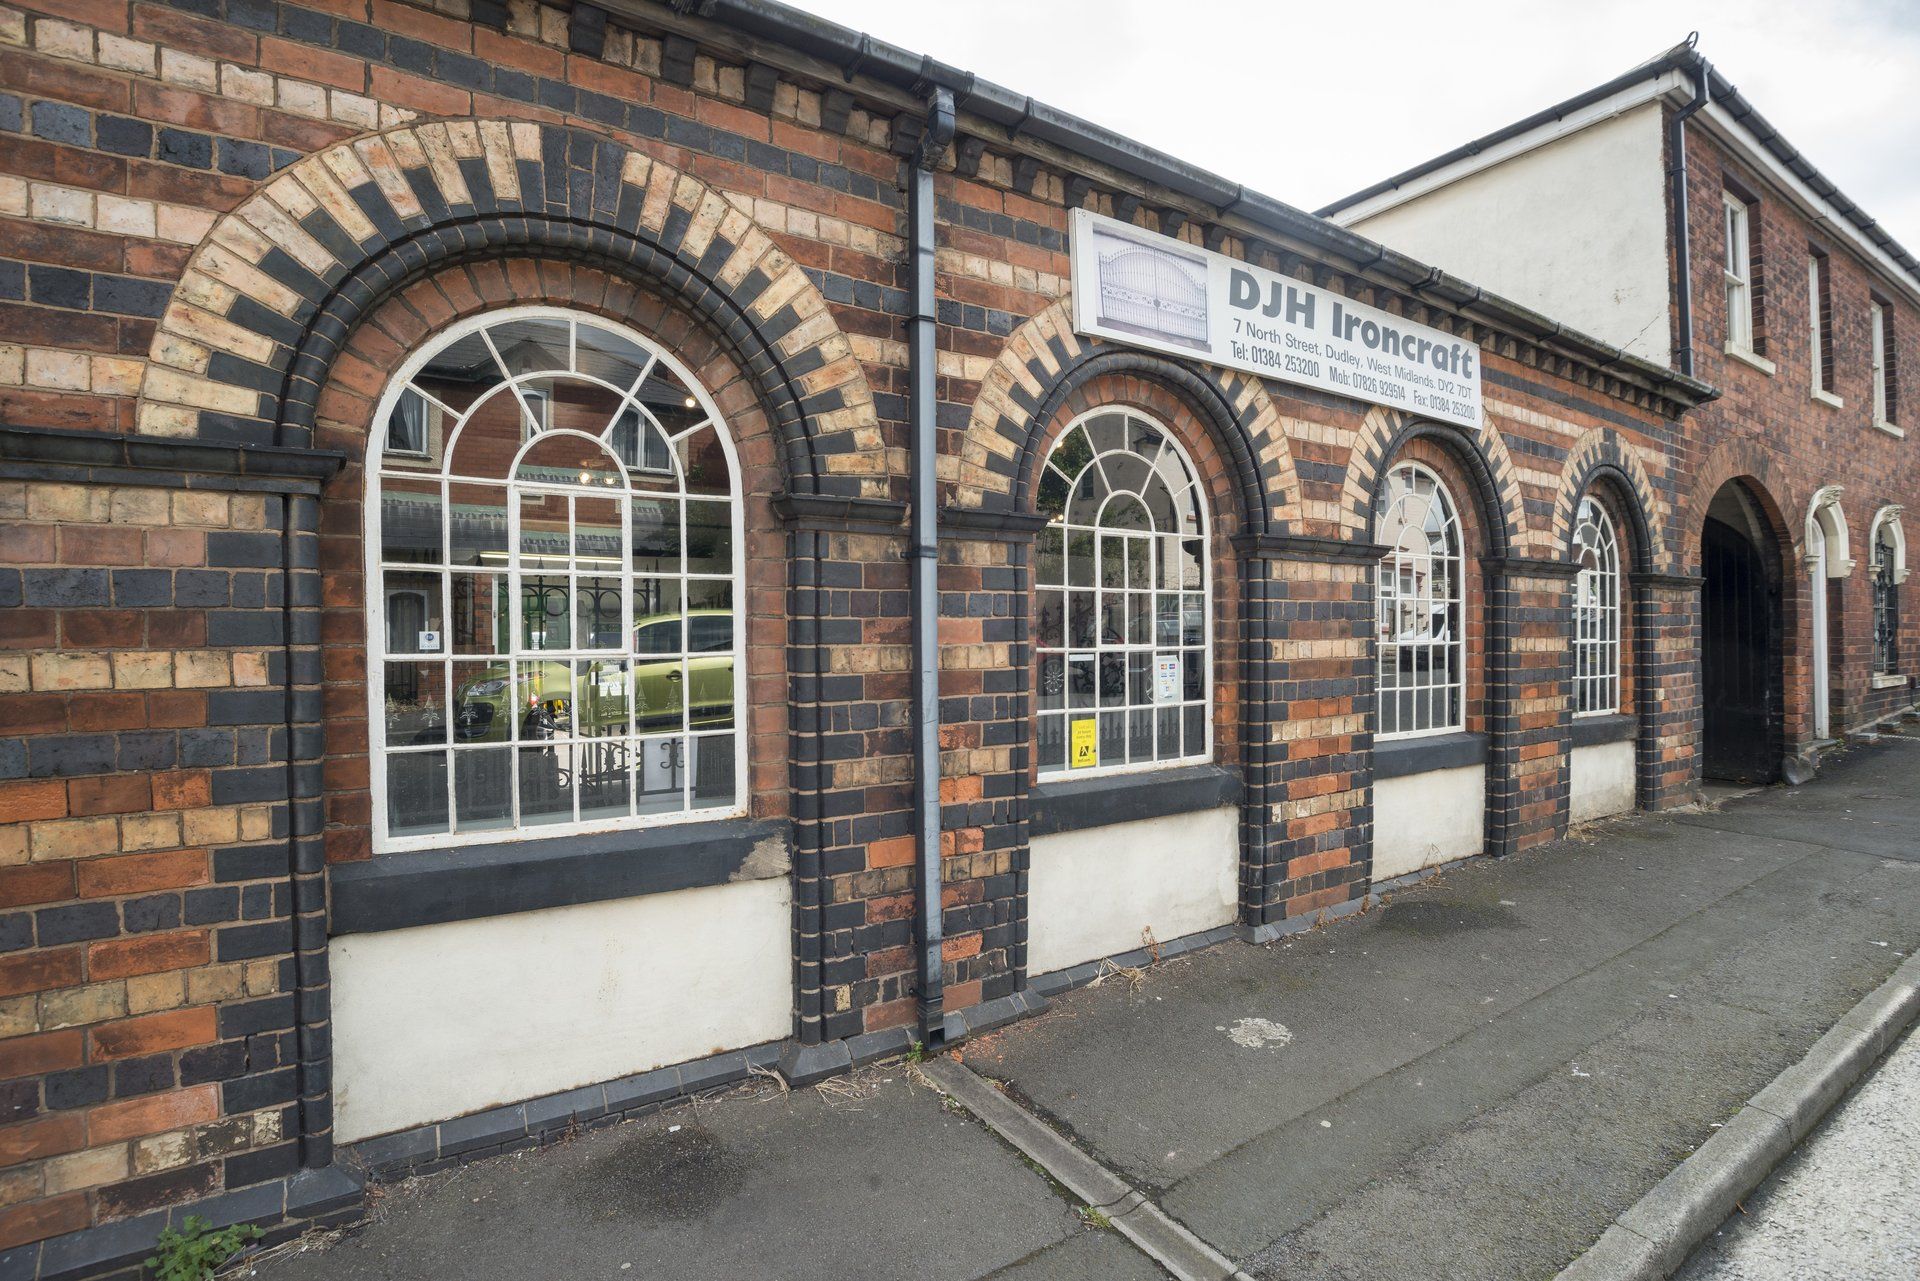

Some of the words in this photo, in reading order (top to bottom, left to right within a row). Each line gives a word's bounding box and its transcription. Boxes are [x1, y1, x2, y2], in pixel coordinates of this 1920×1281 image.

[1228, 267, 1316, 330] DJH
[1332, 301, 1473, 379] Ironcraft
[1233, 317, 1242, 333] 7
[1246, 321, 1281, 345] North
[1285, 332, 1322, 357] Street,
[1325, 344, 1364, 369] Dudley,
[1366, 356, 1392, 376] West
[1438, 378, 1455, 395] DY2
[1456, 383, 1473, 400] 7DT
[1230, 340, 1249, 361] Tel:
[1251, 345, 1281, 369] 01384
[1285, 354, 1320, 378] 253200
[1329, 366, 1351, 387] Mob:
[1352, 372, 1378, 394] 07826
[1379, 380, 1406, 401] 929514
[1413, 389, 1429, 407] Fax:
[1429, 394, 1450, 413] 01384
[1451, 400, 1476, 421] 253200
